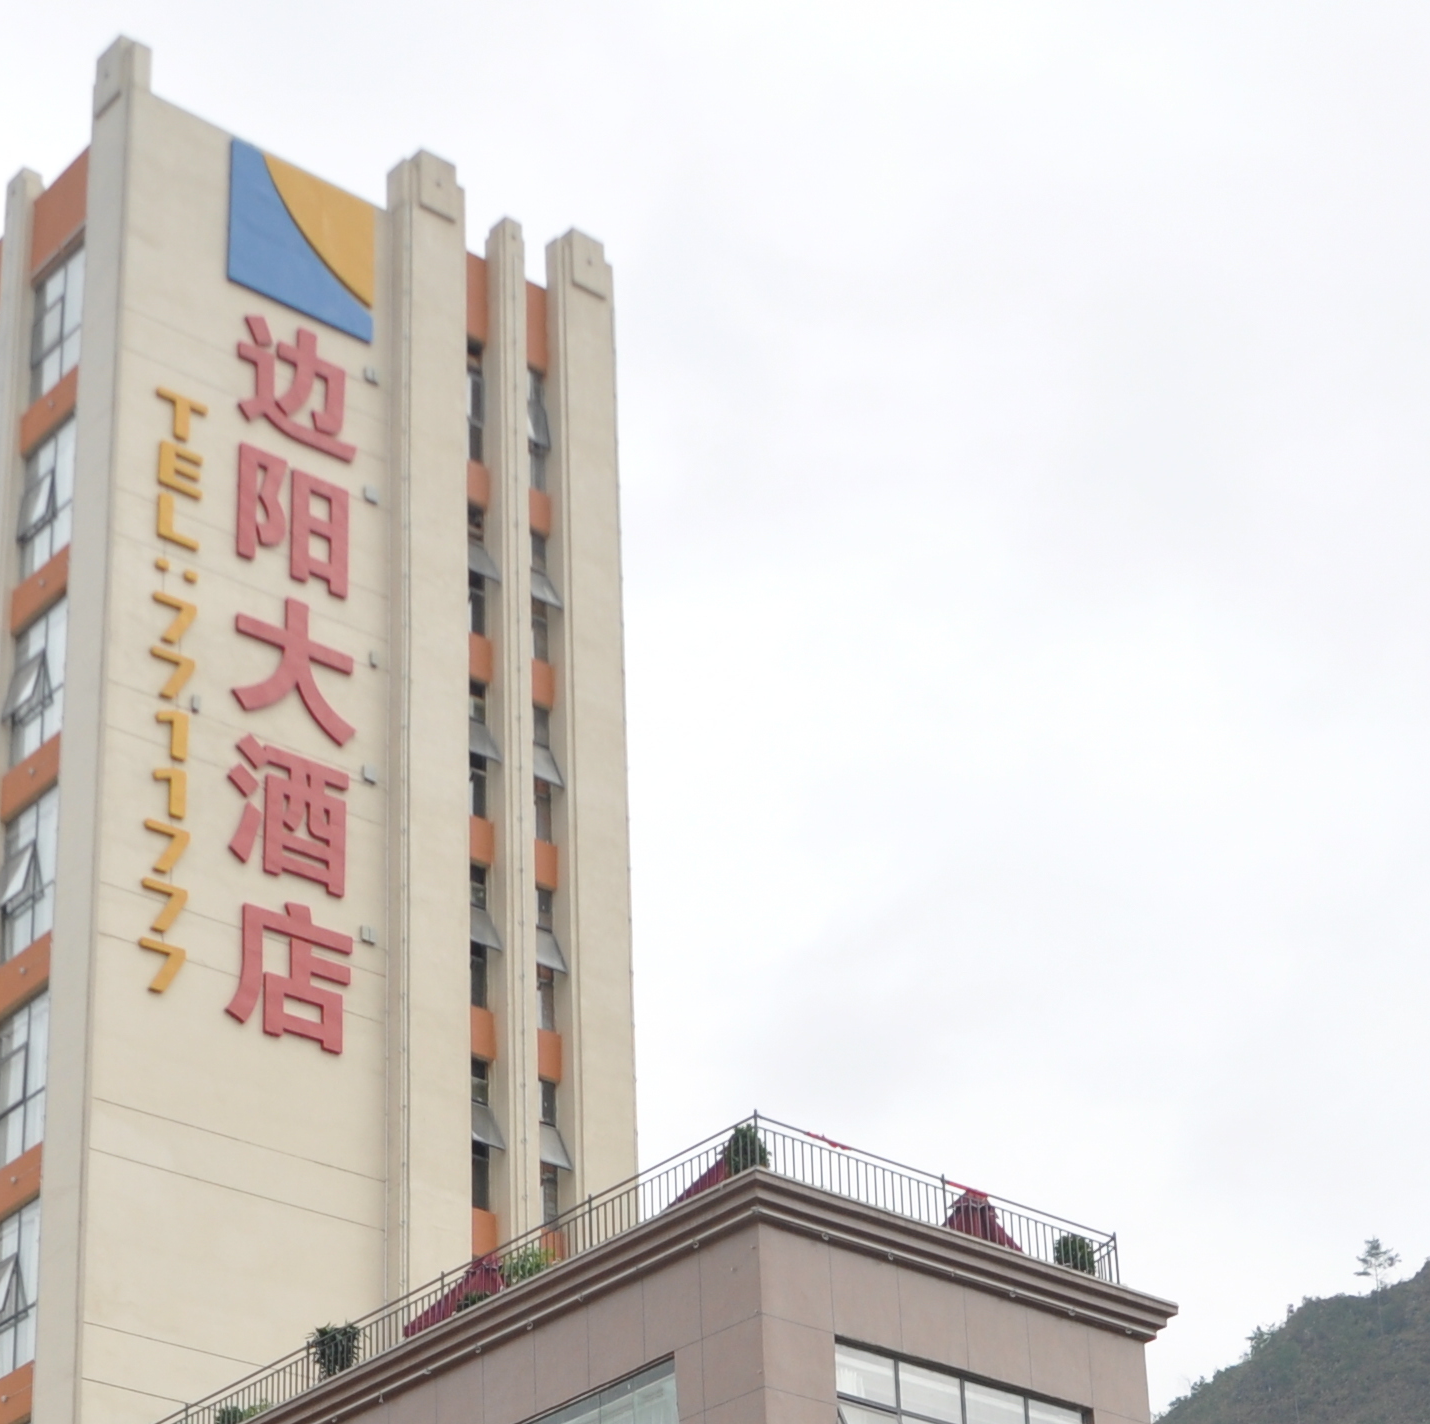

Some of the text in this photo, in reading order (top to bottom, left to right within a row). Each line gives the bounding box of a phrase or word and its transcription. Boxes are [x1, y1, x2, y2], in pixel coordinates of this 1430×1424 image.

[225, 315, 355, 1055] 边阳大酒店
